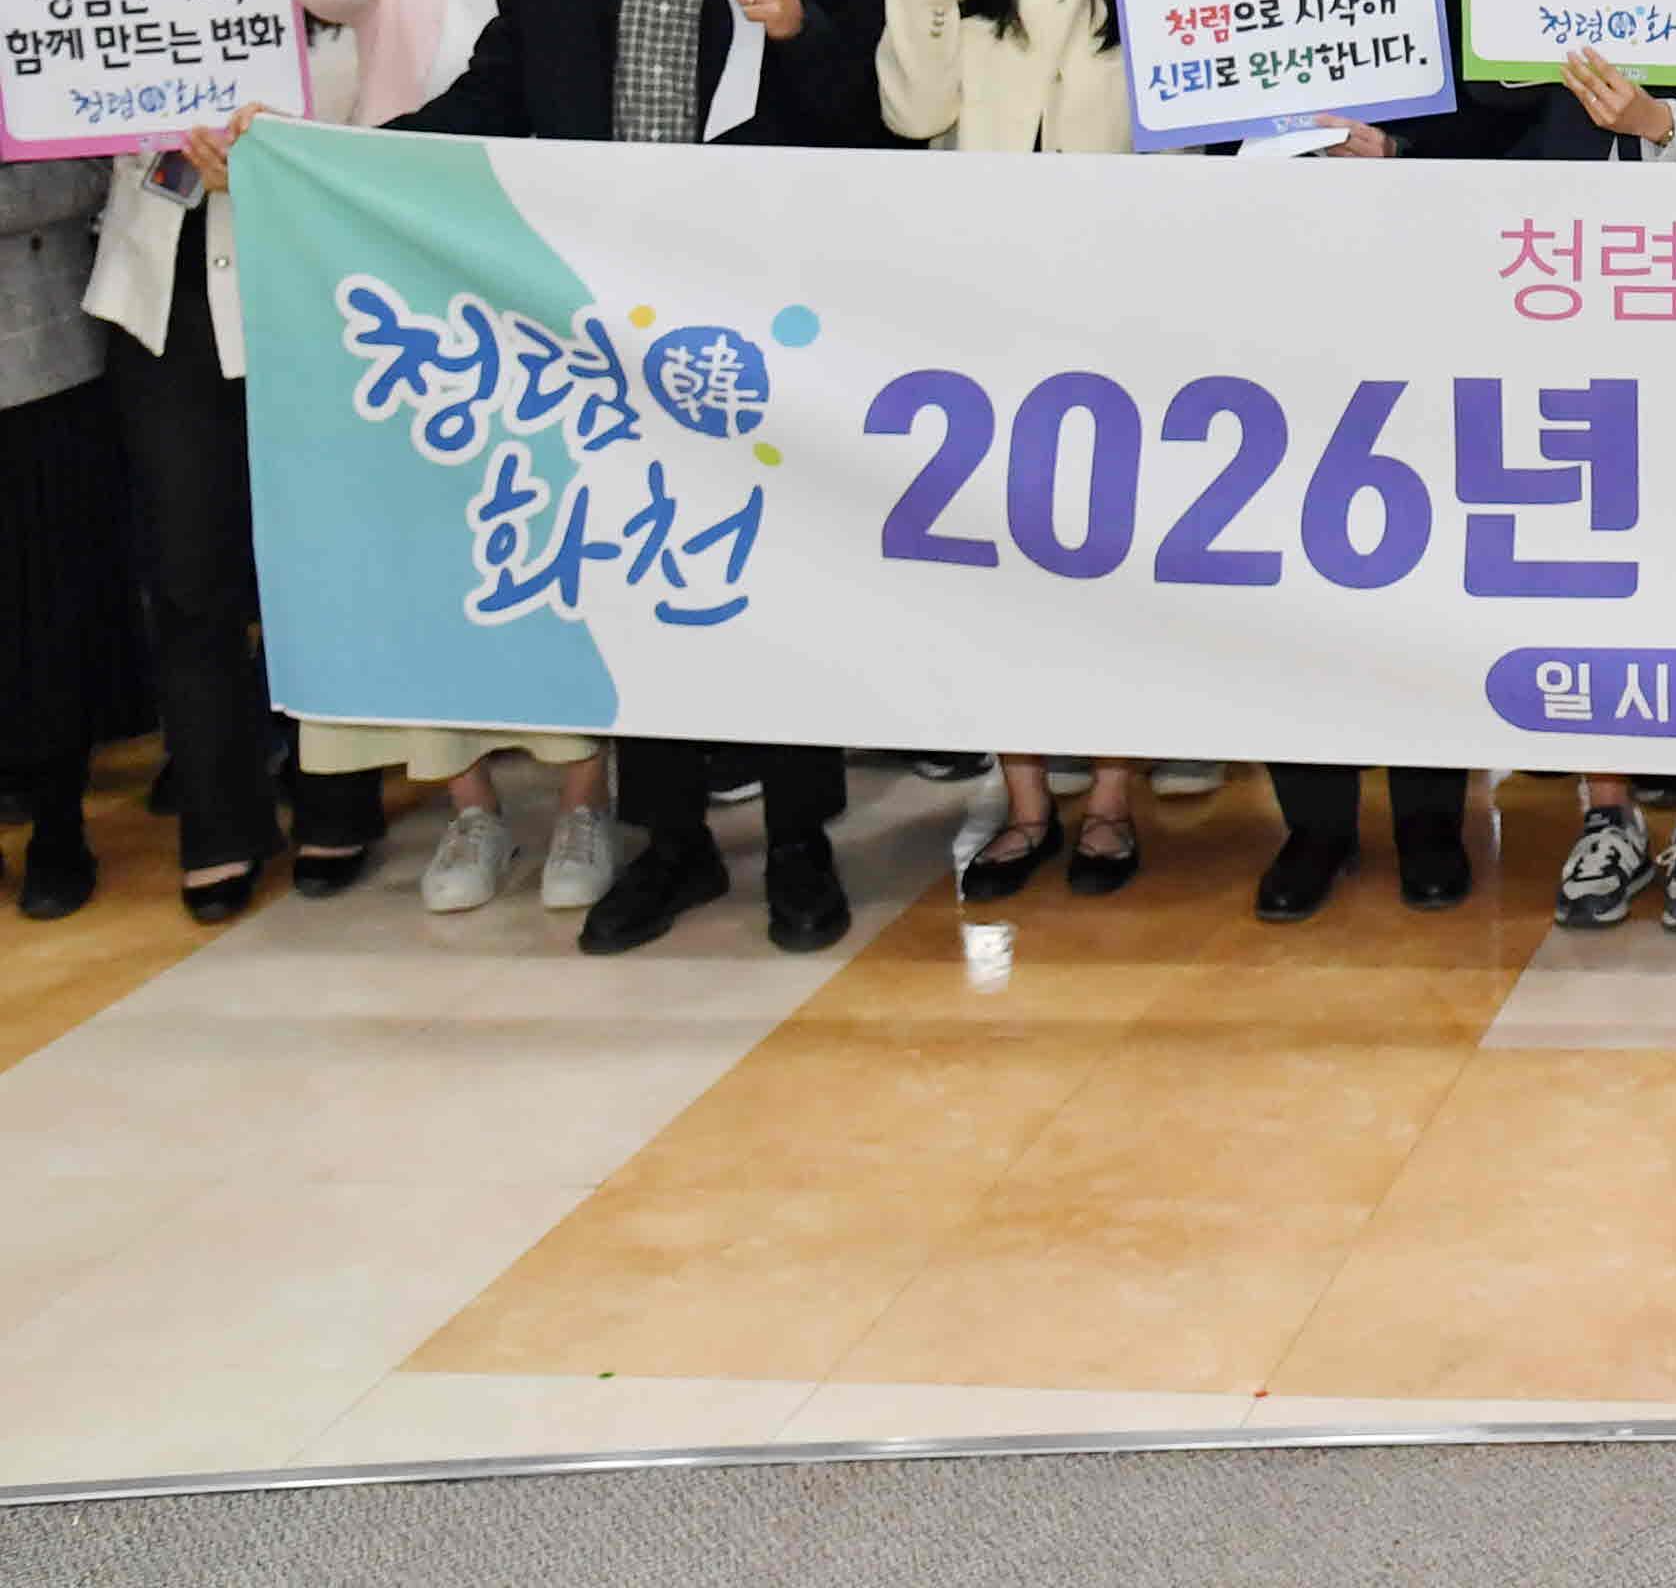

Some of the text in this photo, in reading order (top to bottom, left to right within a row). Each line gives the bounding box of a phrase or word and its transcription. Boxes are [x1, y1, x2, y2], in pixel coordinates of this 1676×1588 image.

[6, 14, 285, 76] 함께 만드는 변화
[1149, 34, 1428, 102] 신뢰로 완성합니다.
[476, 453, 764, 626] 화천
[863, 368, 1640, 599] 2026년
